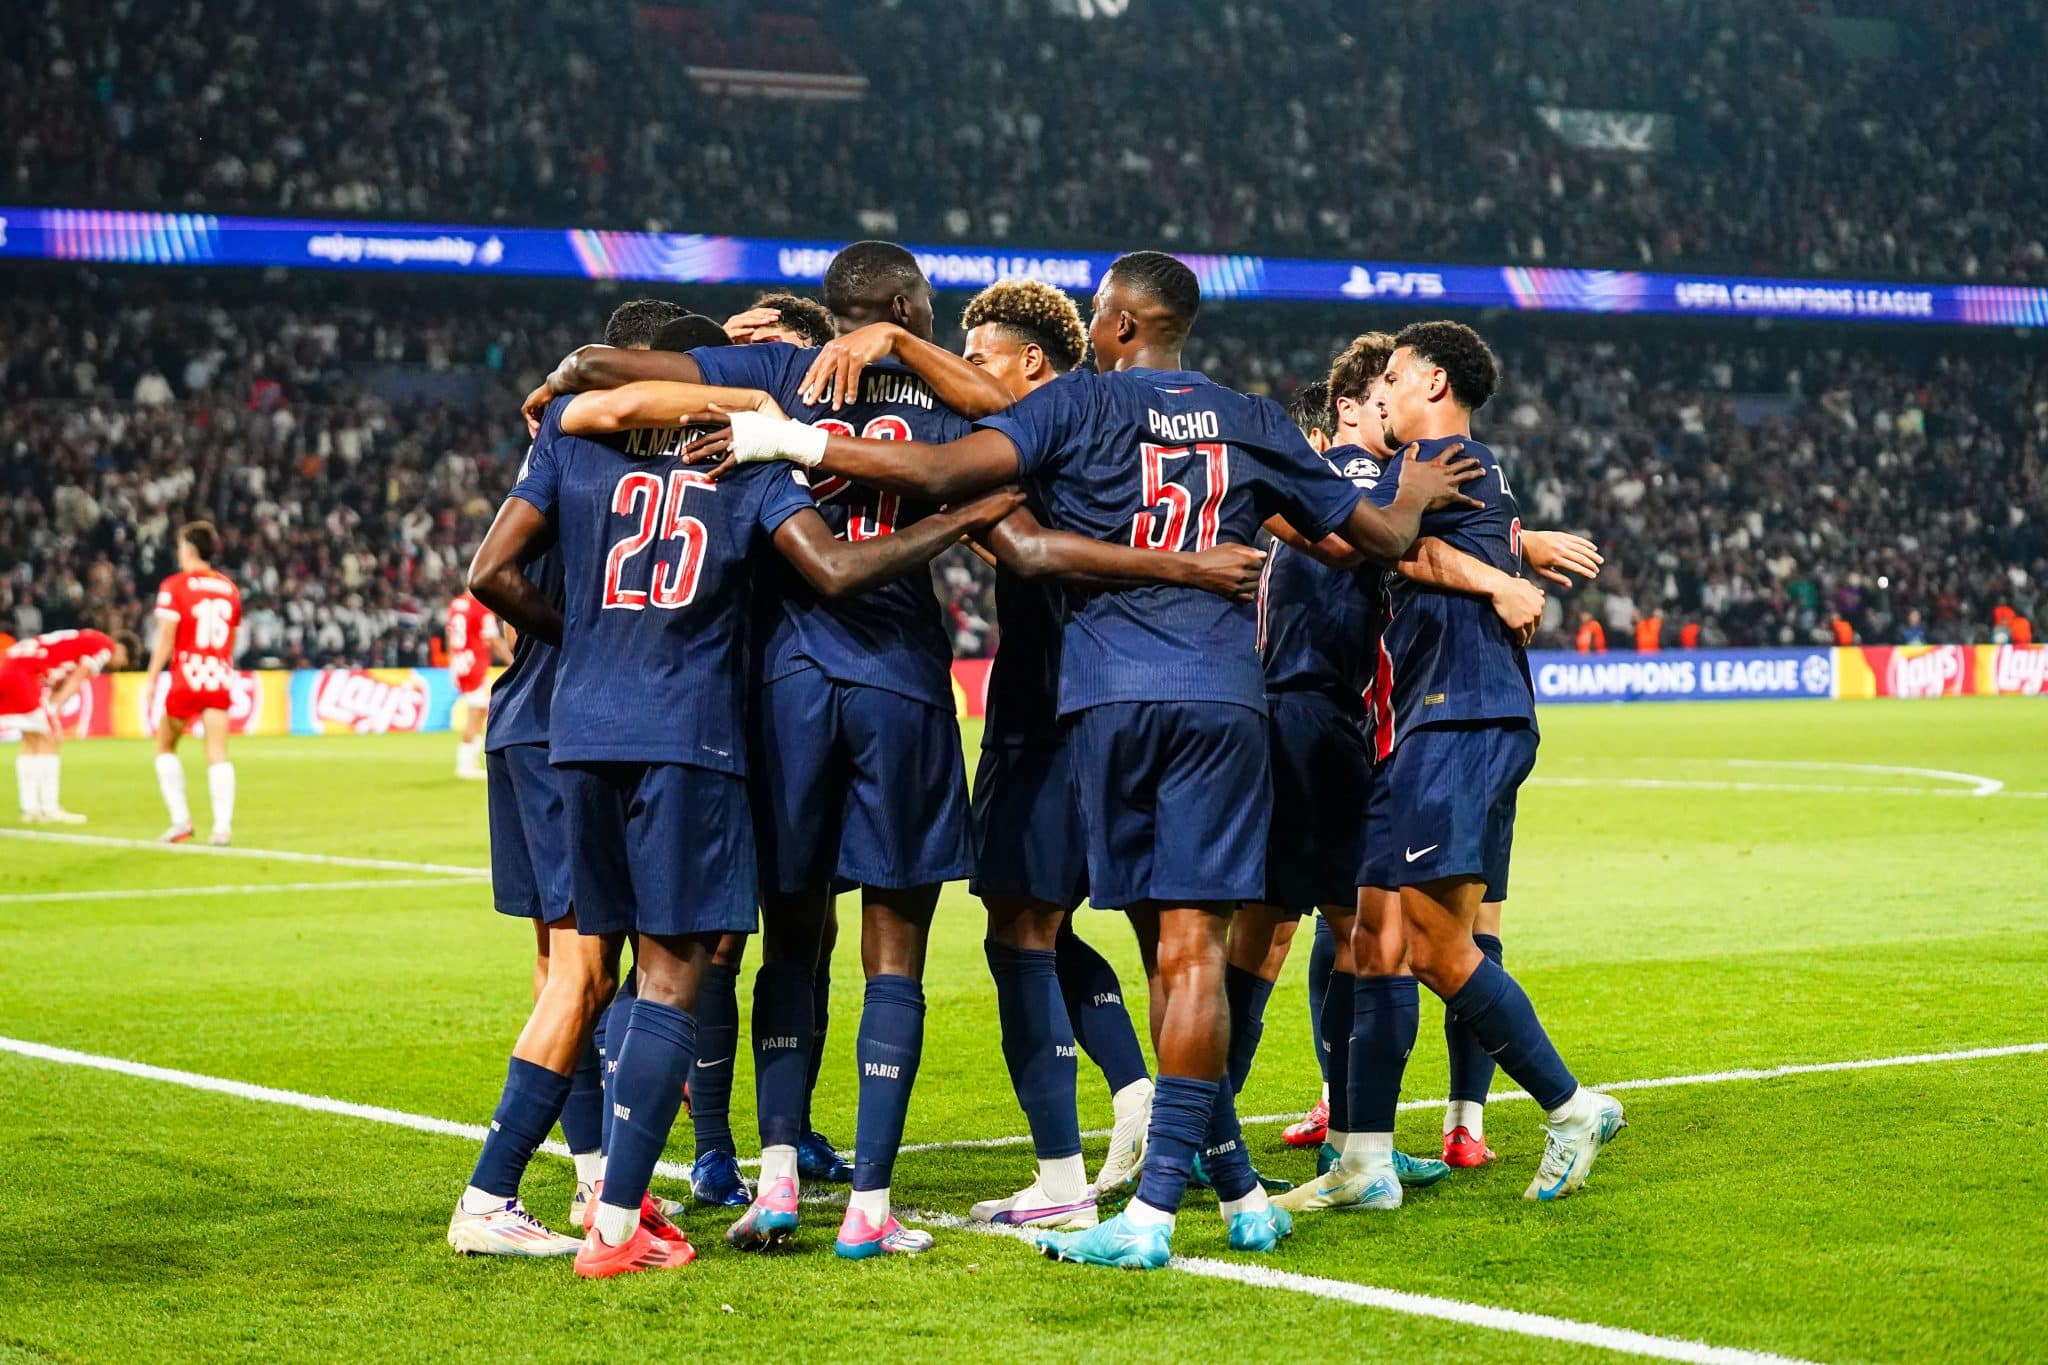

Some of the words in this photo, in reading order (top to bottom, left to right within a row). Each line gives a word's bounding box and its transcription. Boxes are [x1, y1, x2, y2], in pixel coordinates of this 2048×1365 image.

[308, 233, 362, 262] enjoy
[1375, 271, 1444, 296] PS5
[1675, 282, 1731, 308] UEFA
[1732, 285, 1854, 313] CHAMPIONS
[1855, 290, 1933, 317] LEAGUE
[865, 374, 933, 409] MUANI
[1148, 408, 1219, 441] PACHO
[602, 469, 718, 610] 25
[191, 598, 232, 649] 16
[1539, 663, 1696, 695] CHAMPIONS
[1701, 660, 1799, 692] LEAGUE
[761, 1036, 798, 1051] PARIS
[864, 1062, 900, 1079] PARIS
[1206, 1139, 1237, 1157] PARIS
